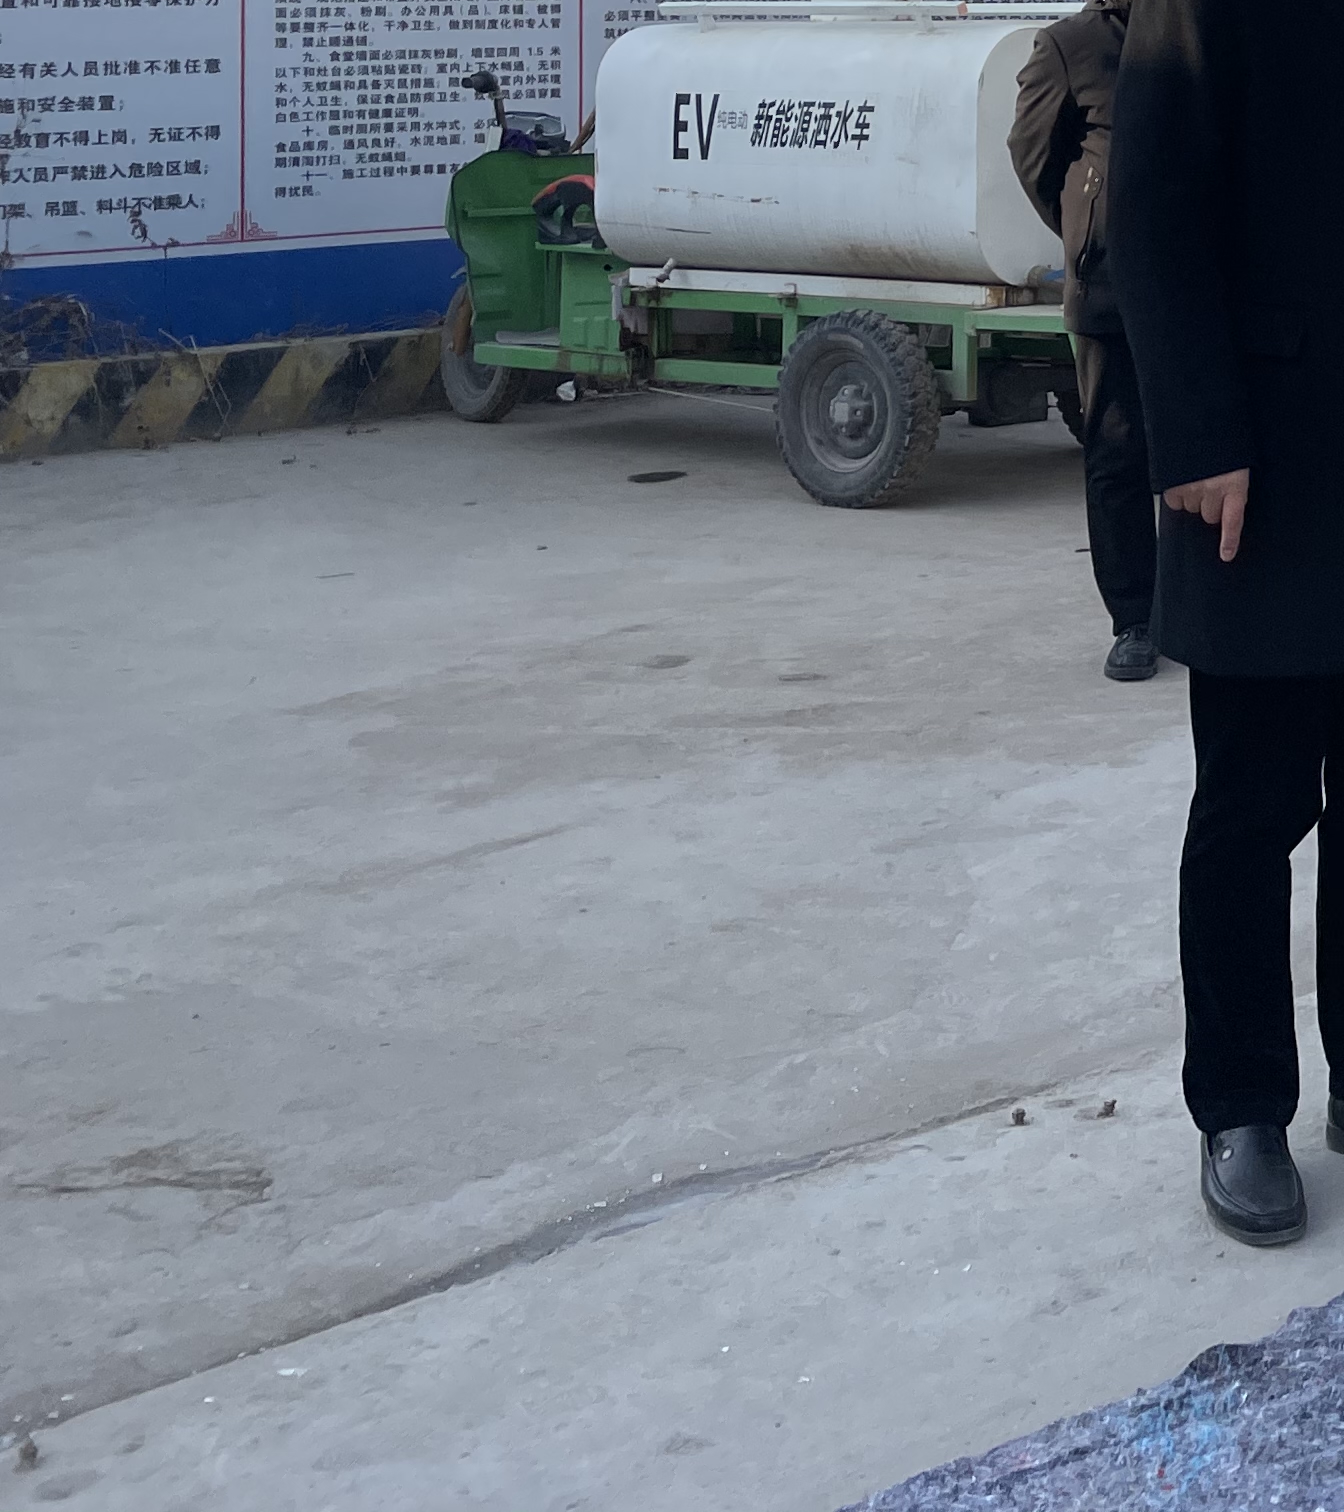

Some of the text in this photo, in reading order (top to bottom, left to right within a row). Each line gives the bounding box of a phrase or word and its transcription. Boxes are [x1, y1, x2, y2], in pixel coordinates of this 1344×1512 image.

[673, 93, 720, 160] EV
[750, 100, 875, 150] 新能源洒水车
